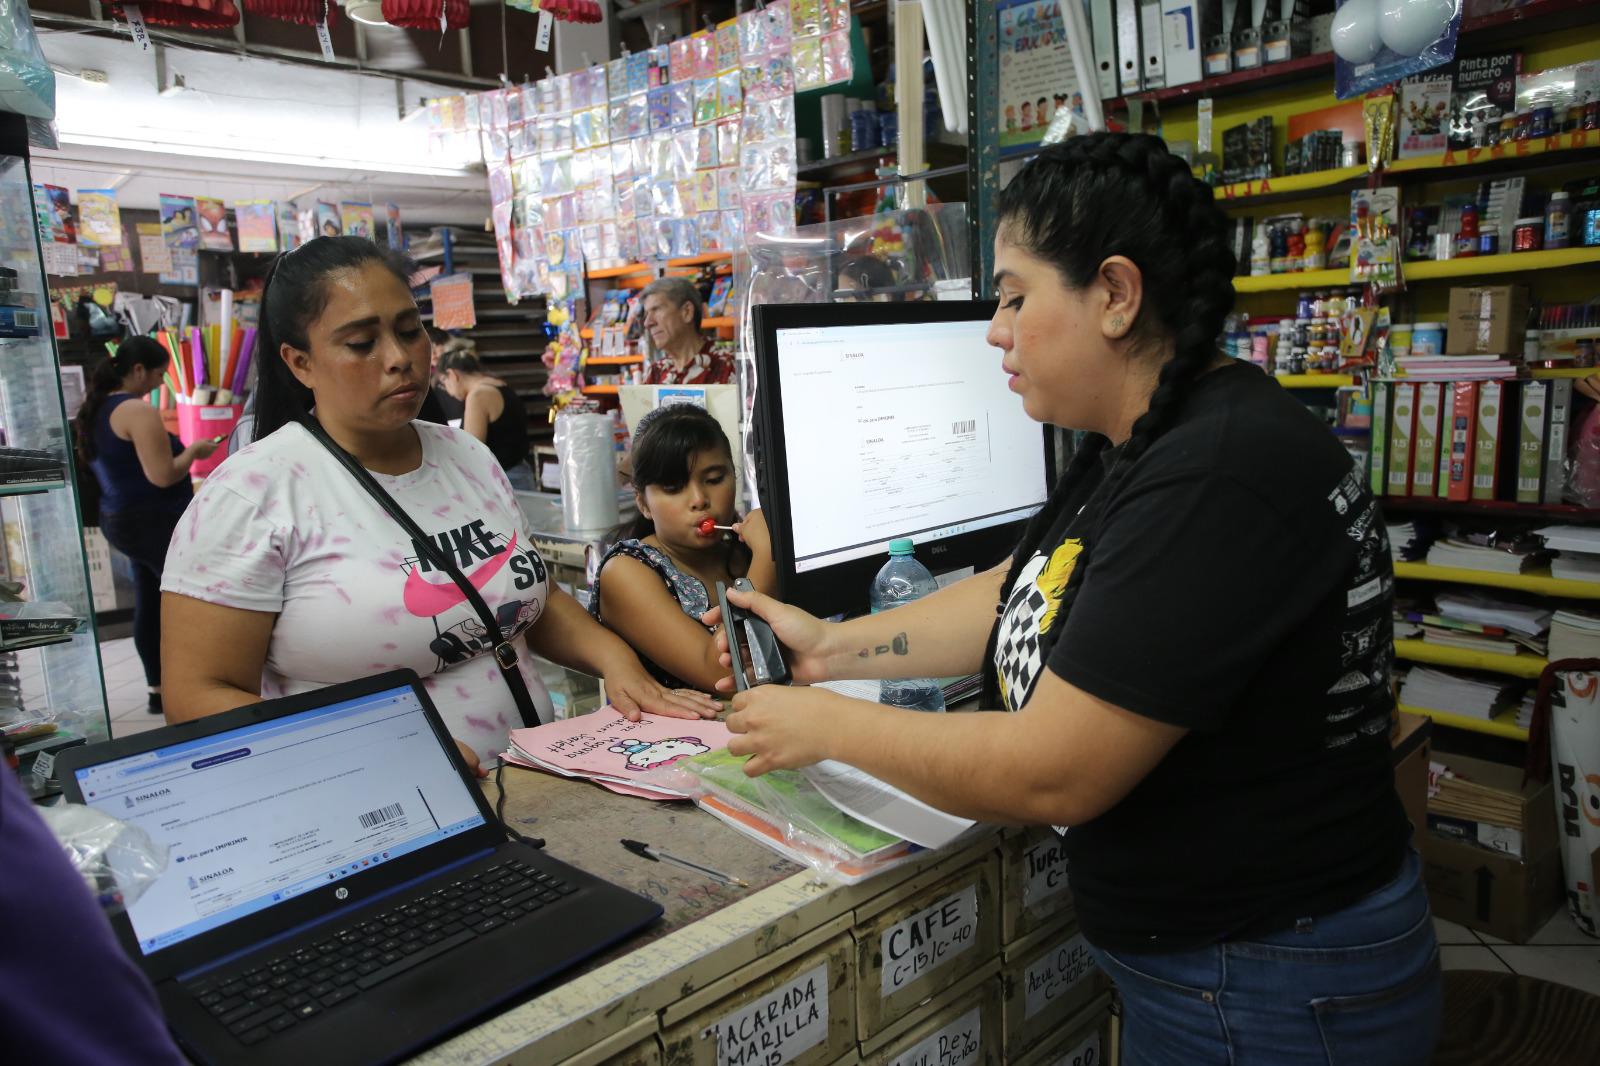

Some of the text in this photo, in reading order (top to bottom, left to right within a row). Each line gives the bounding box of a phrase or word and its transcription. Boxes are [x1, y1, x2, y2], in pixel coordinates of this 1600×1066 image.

[1459, 58, 1488, 71] Pinta
[1491, 54, 1513, 67] por
[1497, 81, 1512, 94] 99
[411, 519, 547, 591] NIKE SB
[931, 545, 948, 555] DELL
[135, 787, 171, 802] SINALOA
[215, 836, 249, 852] IMPRIMIR
[198, 867, 235, 882] SINALOA
[888, 898, 961, 961] CAFE
